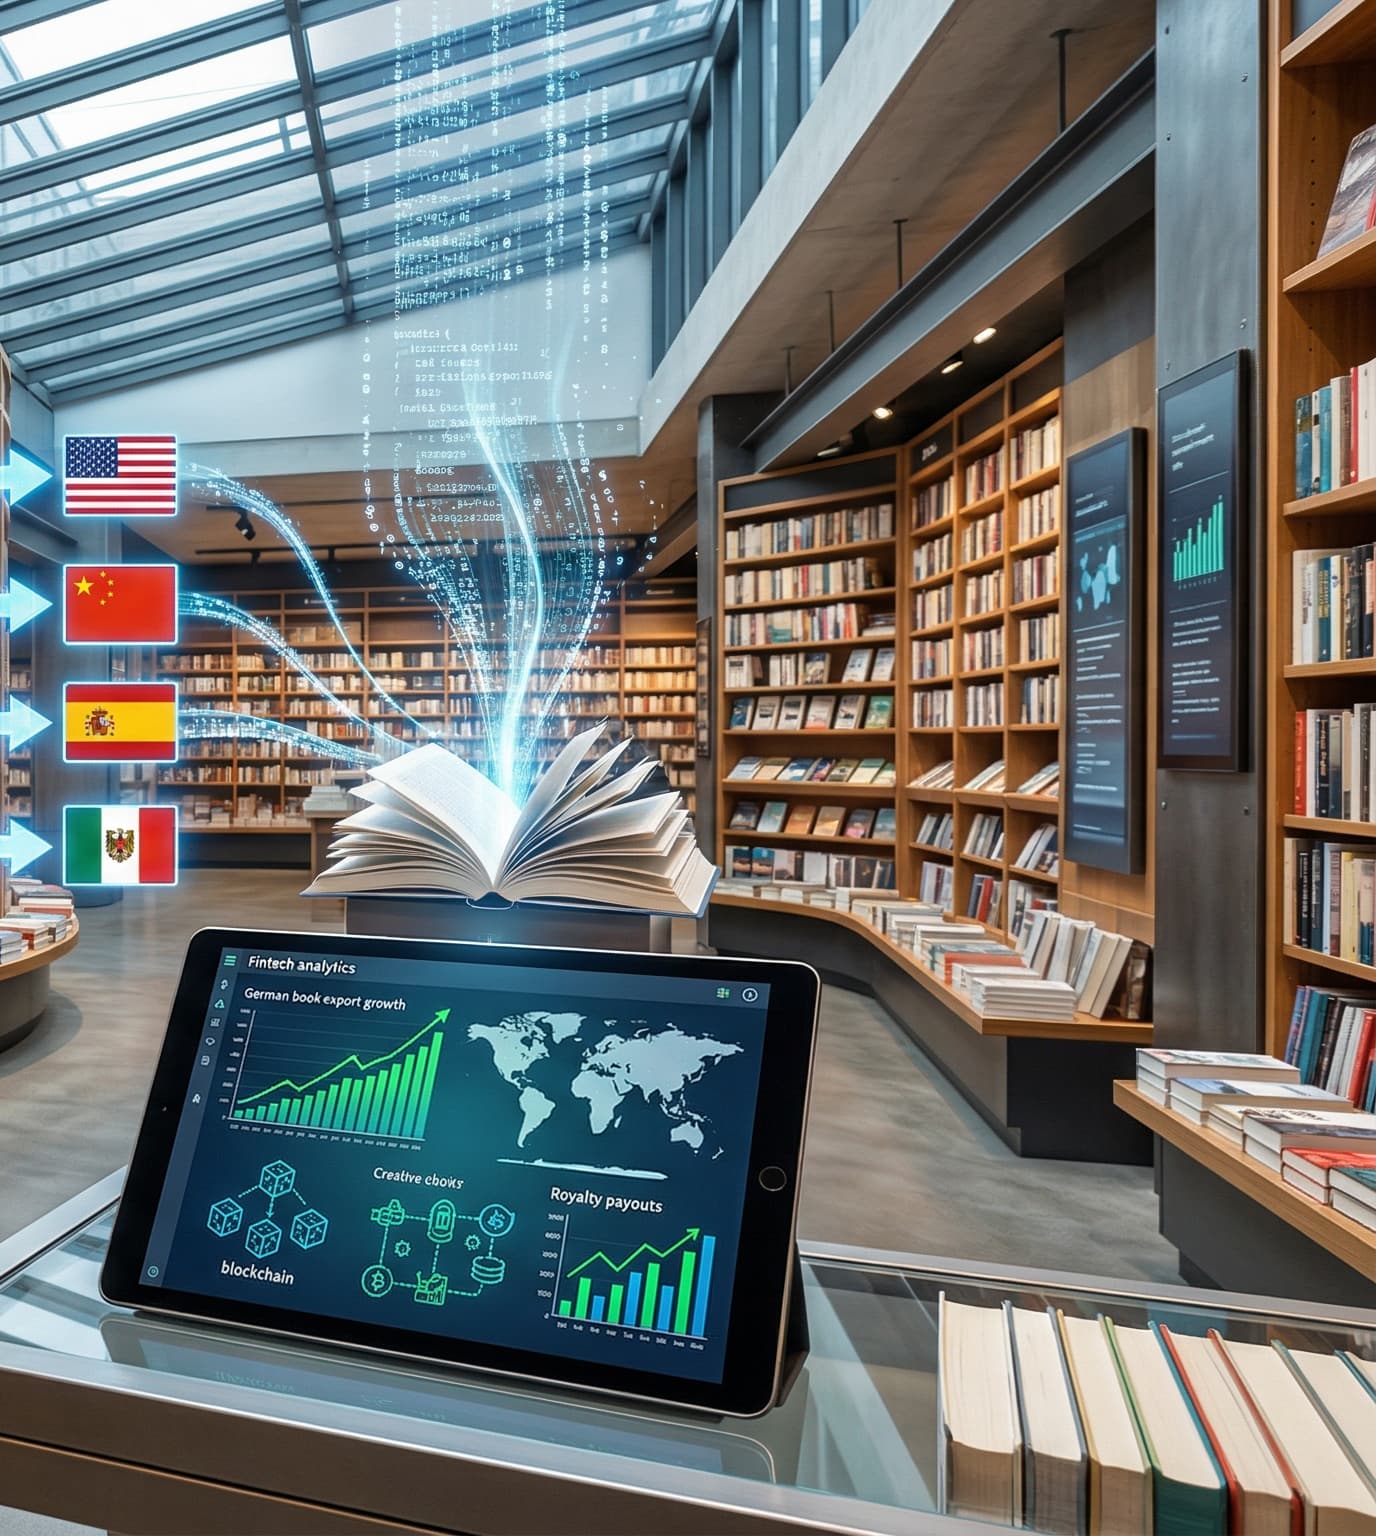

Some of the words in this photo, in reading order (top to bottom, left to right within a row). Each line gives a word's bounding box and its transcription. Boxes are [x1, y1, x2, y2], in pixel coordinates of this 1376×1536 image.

[248, 955, 294, 971] Fintech
[296, 959, 356, 976] analytics
[244, 987, 289, 1002] German
[292, 990, 321, 1005] book
[323, 995, 362, 1009] export
[363, 998, 406, 1011] growth
[373, 1167, 422, 1184] Creative
[550, 1186, 603, 1209] Royalty
[605, 1196, 664, 1213] payouts
[220, 1259, 295, 1285] blockchain
